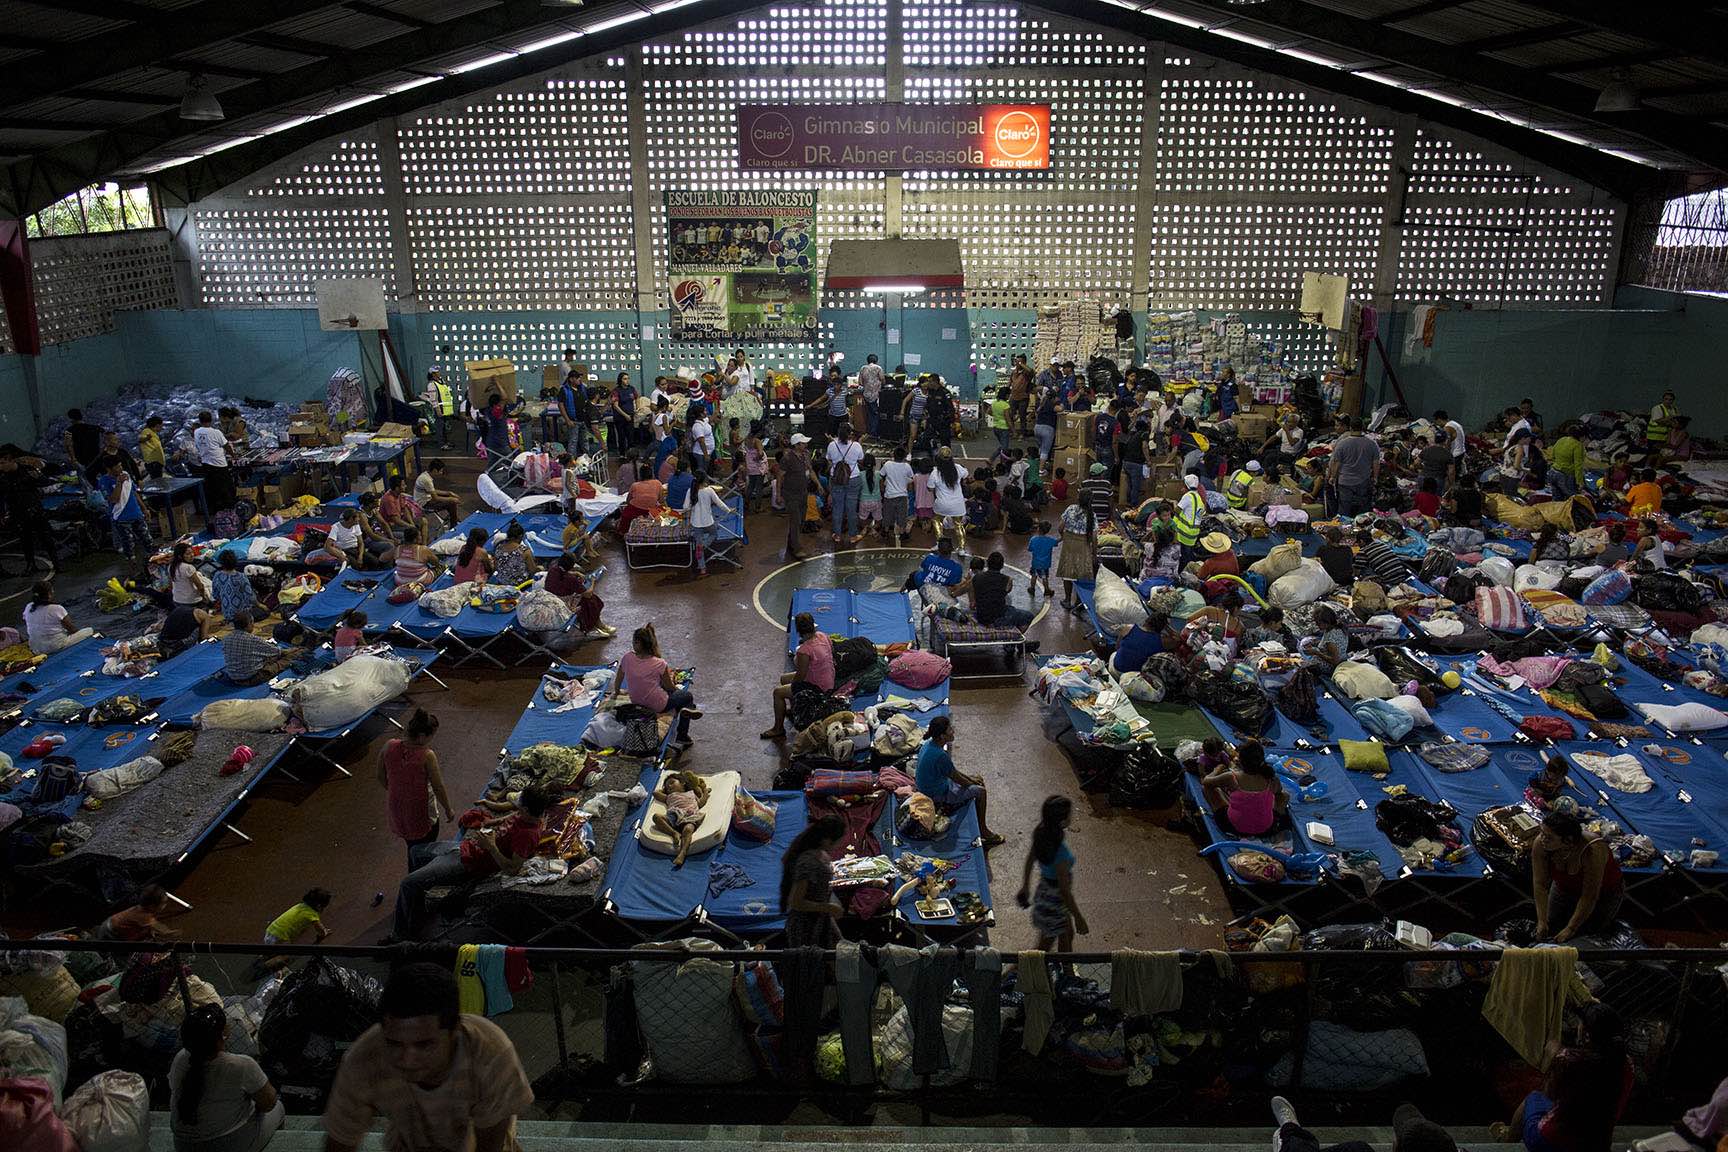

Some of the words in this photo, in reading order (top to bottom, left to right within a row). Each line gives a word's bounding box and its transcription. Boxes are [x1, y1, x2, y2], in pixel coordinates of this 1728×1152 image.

[804, 116, 890, 135] Gimnasio
[896, 115, 985, 139] Municipal
[753, 128, 786, 140] Claro
[998, 128, 1030, 140] Claro
[804, 145, 837, 164] DR.
[841, 145, 897, 164] Abner
[902, 145, 984, 164] Casasola
[746, 158, 770, 167] Claro
[771, 160, 788, 169] que
[990, 158, 1015, 168] Claro
[1015, 159, 1033, 168] que
[668, 191, 719, 206] ESCUELA
[721, 191, 737, 206] DE
[738, 191, 814, 206] BALONCESTO
[669, 207, 689, 216] DONDE
[672, 263, 699, 273] MANUEL
[700, 263, 743, 273] VALLADARES
[681, 331, 703, 340] para
